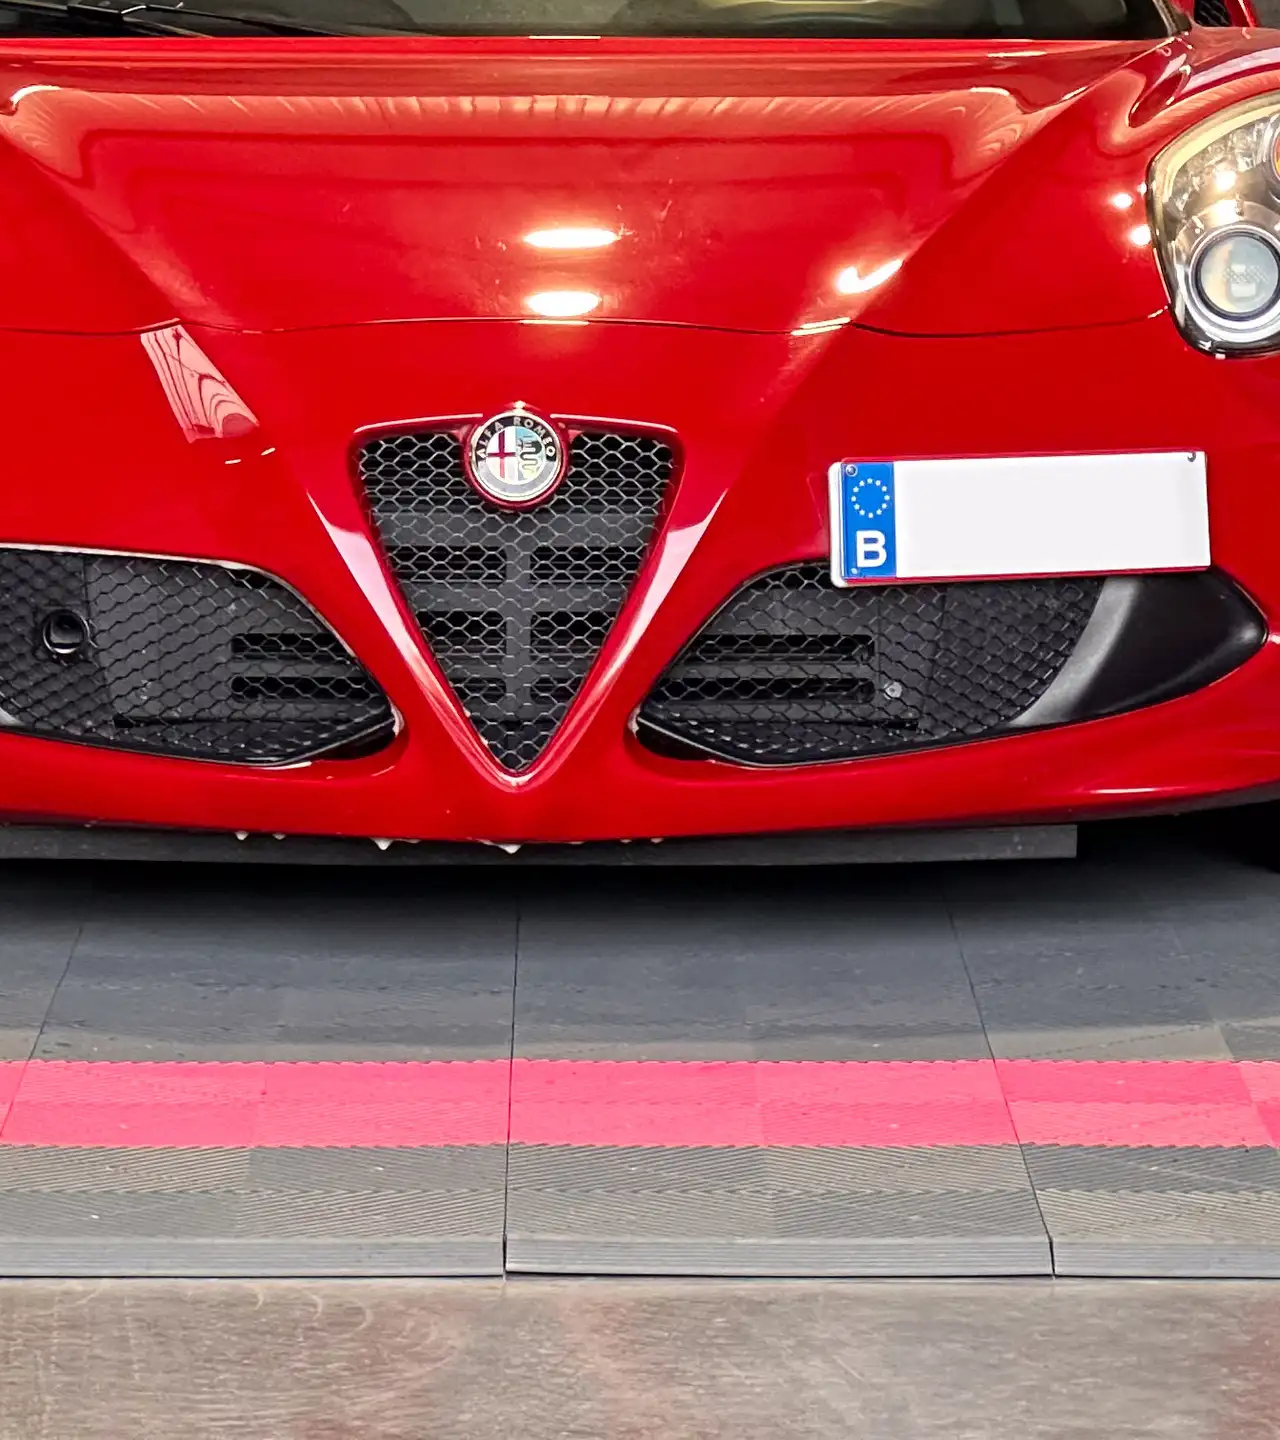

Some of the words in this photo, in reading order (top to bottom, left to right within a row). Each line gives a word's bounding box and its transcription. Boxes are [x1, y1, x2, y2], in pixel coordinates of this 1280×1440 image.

[476, 421, 505, 459] ALFA
[513, 417, 556, 457] ROMEO
[856, 530, 887, 568] B
